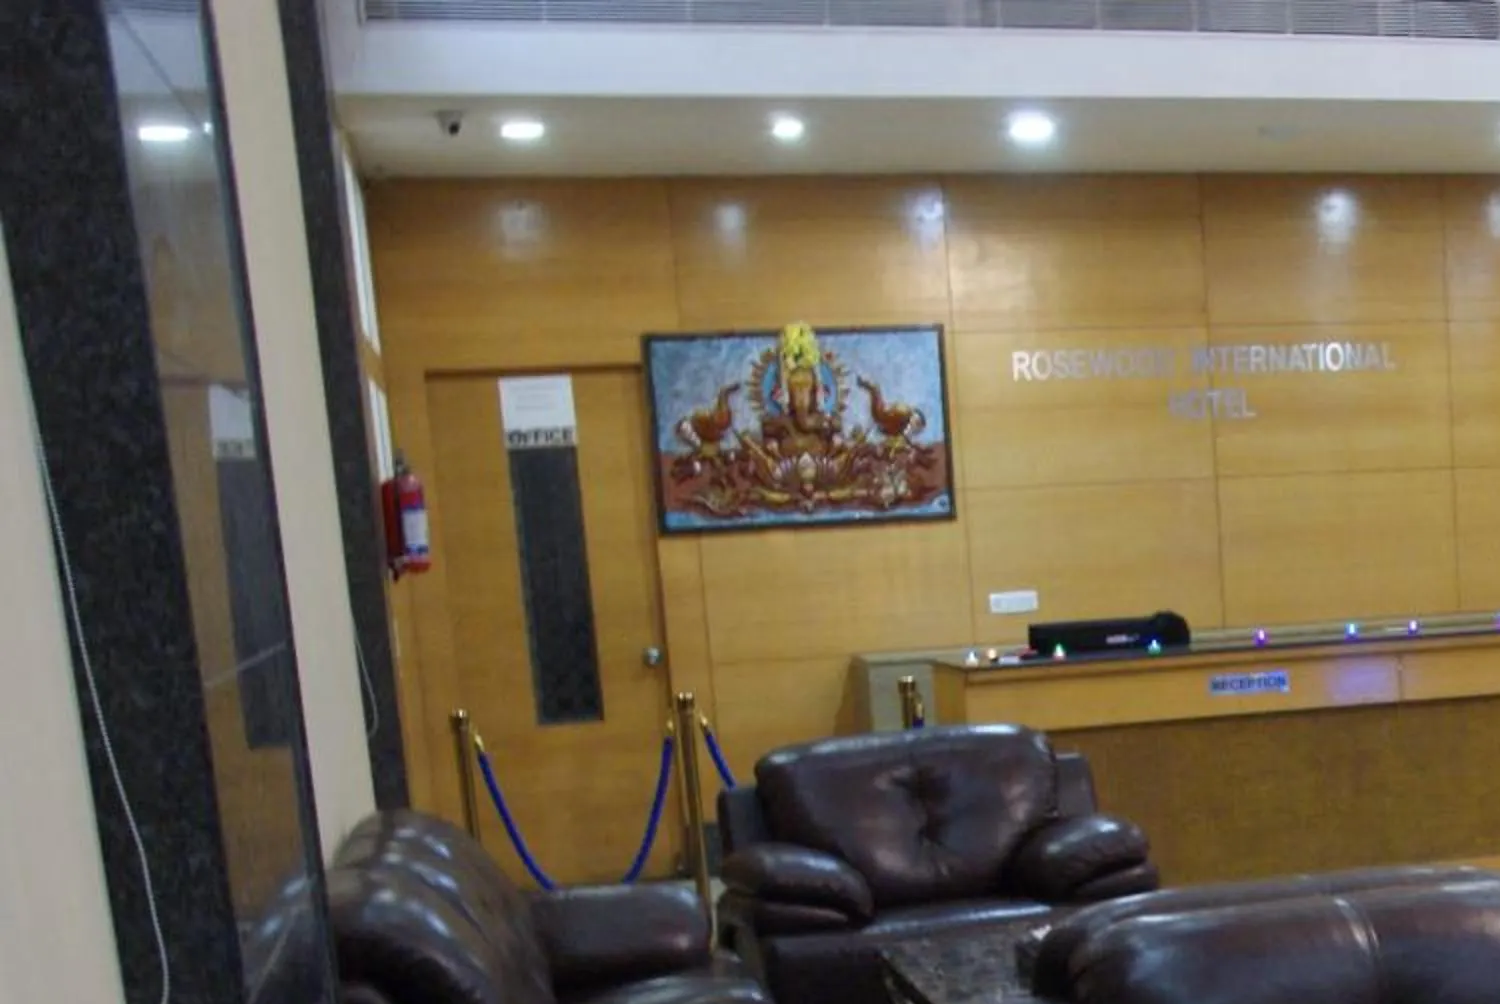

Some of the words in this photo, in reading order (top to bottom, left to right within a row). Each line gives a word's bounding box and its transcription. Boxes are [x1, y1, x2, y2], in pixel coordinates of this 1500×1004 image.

[1011, 346, 1175, 381] ROSEWOOD
[1191, 341, 1397, 376] INTERNATIONAL
[1167, 389, 1257, 419] HOTEL
[508, 428, 574, 446] OFFICE
[1211, 674, 1288, 690] RECEPTION
